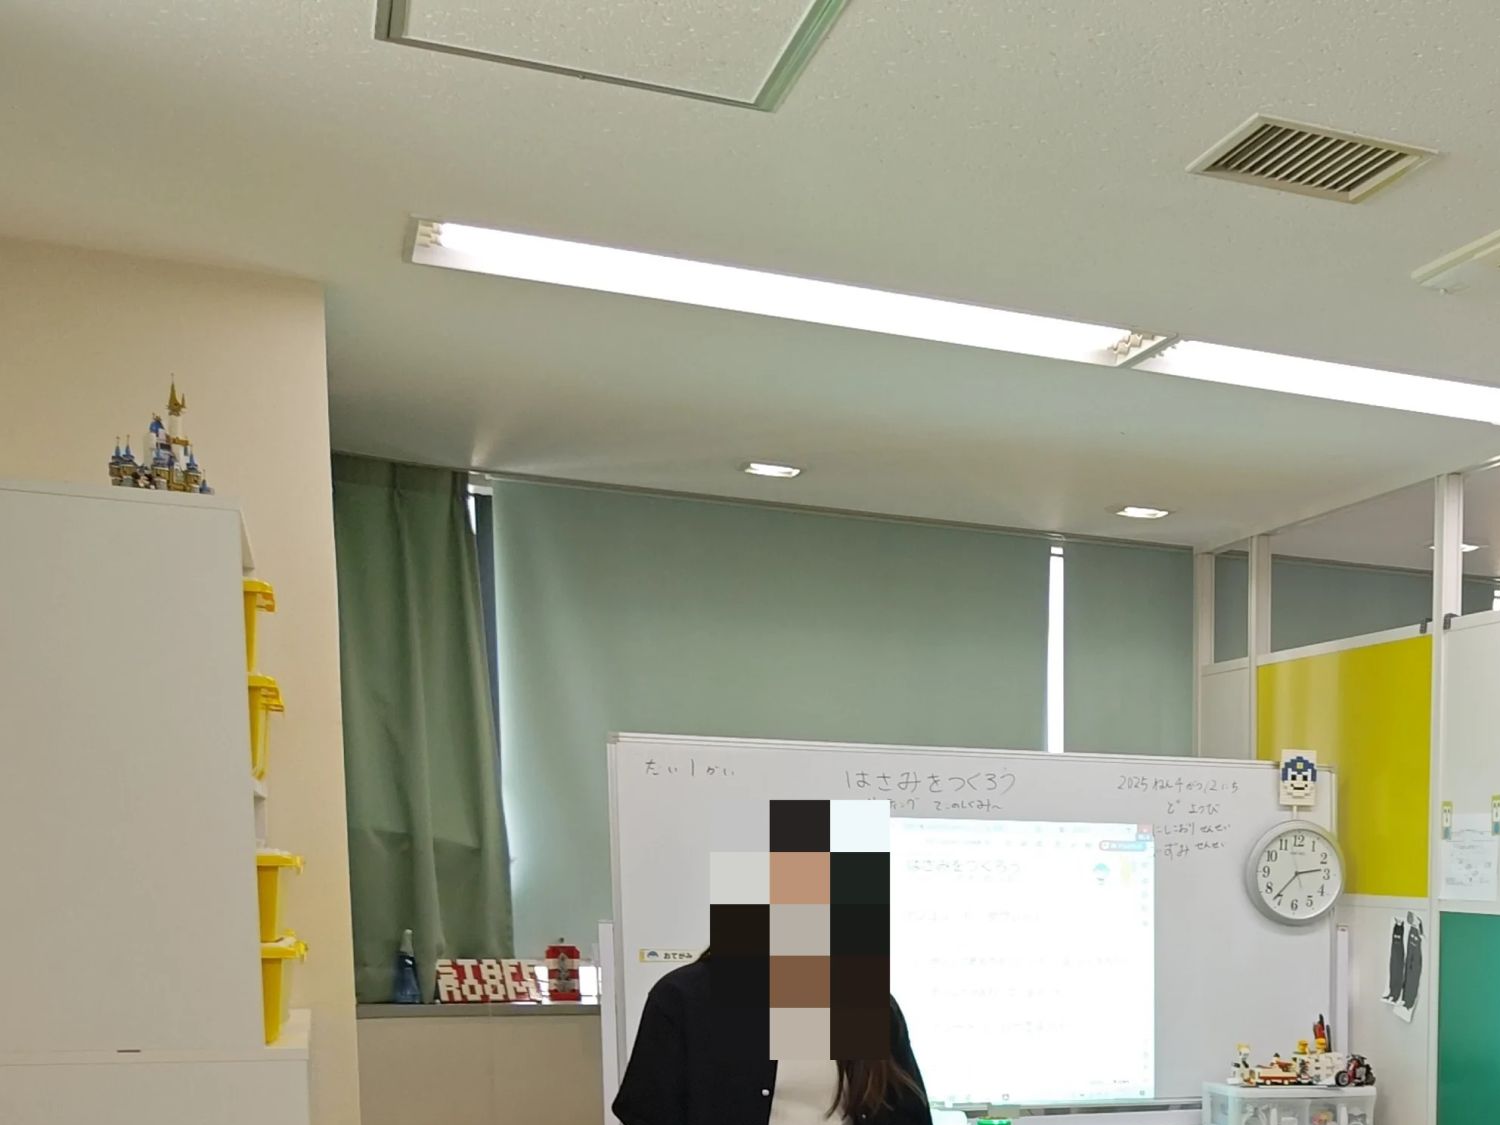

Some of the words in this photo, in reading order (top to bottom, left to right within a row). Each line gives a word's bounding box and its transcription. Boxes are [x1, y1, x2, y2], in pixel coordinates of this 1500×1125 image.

[845, 767, 1017, 796] はさみをつくろう
[1280, 839, 1288, 851] 11
[1293, 835, 1305, 847] 12
[1312, 840, 1316, 852] 1
[1266, 850, 1278, 862] 10
[1320, 852, 1328, 865] 2
[1262, 866, 1270, 878] 9
[1323, 868, 1331, 880] 3
[1265, 882, 1273, 894] 8
[1317, 884, 1325, 896] 4
[1291, 899, 1298, 911] 6
[1306, 895, 1314, 907] 5
[438, 980, 542, 1002] ROOM
